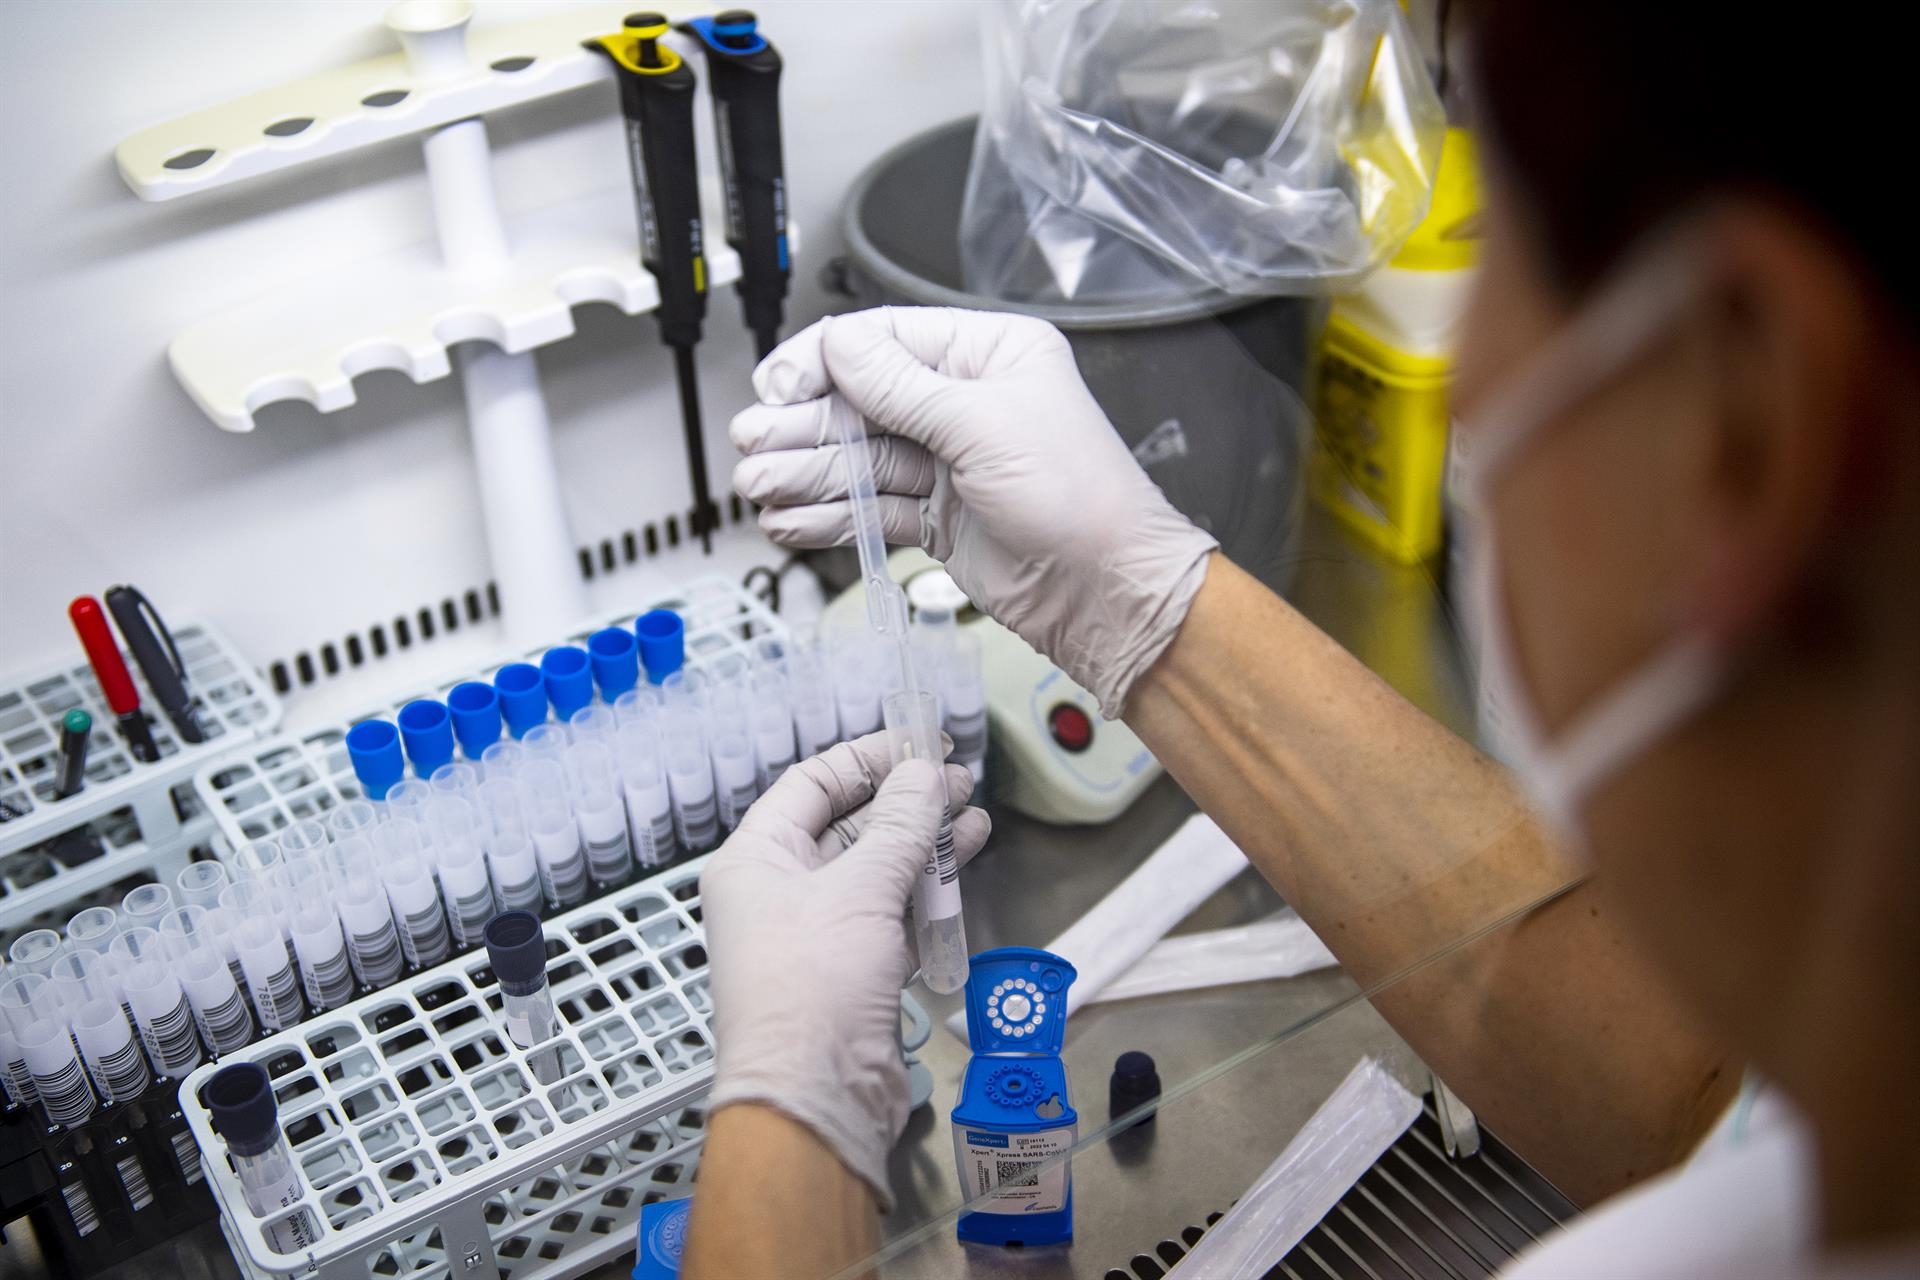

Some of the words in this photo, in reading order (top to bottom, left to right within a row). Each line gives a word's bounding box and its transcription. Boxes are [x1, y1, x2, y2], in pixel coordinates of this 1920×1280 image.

[257, 986, 277, 1020] 78672
[102, 1100, 114, 1108] 19
[47, 1124, 60, 1133] 20
[115, 1136, 128, 1145] 19
[60, 1162, 73, 1171] 20
